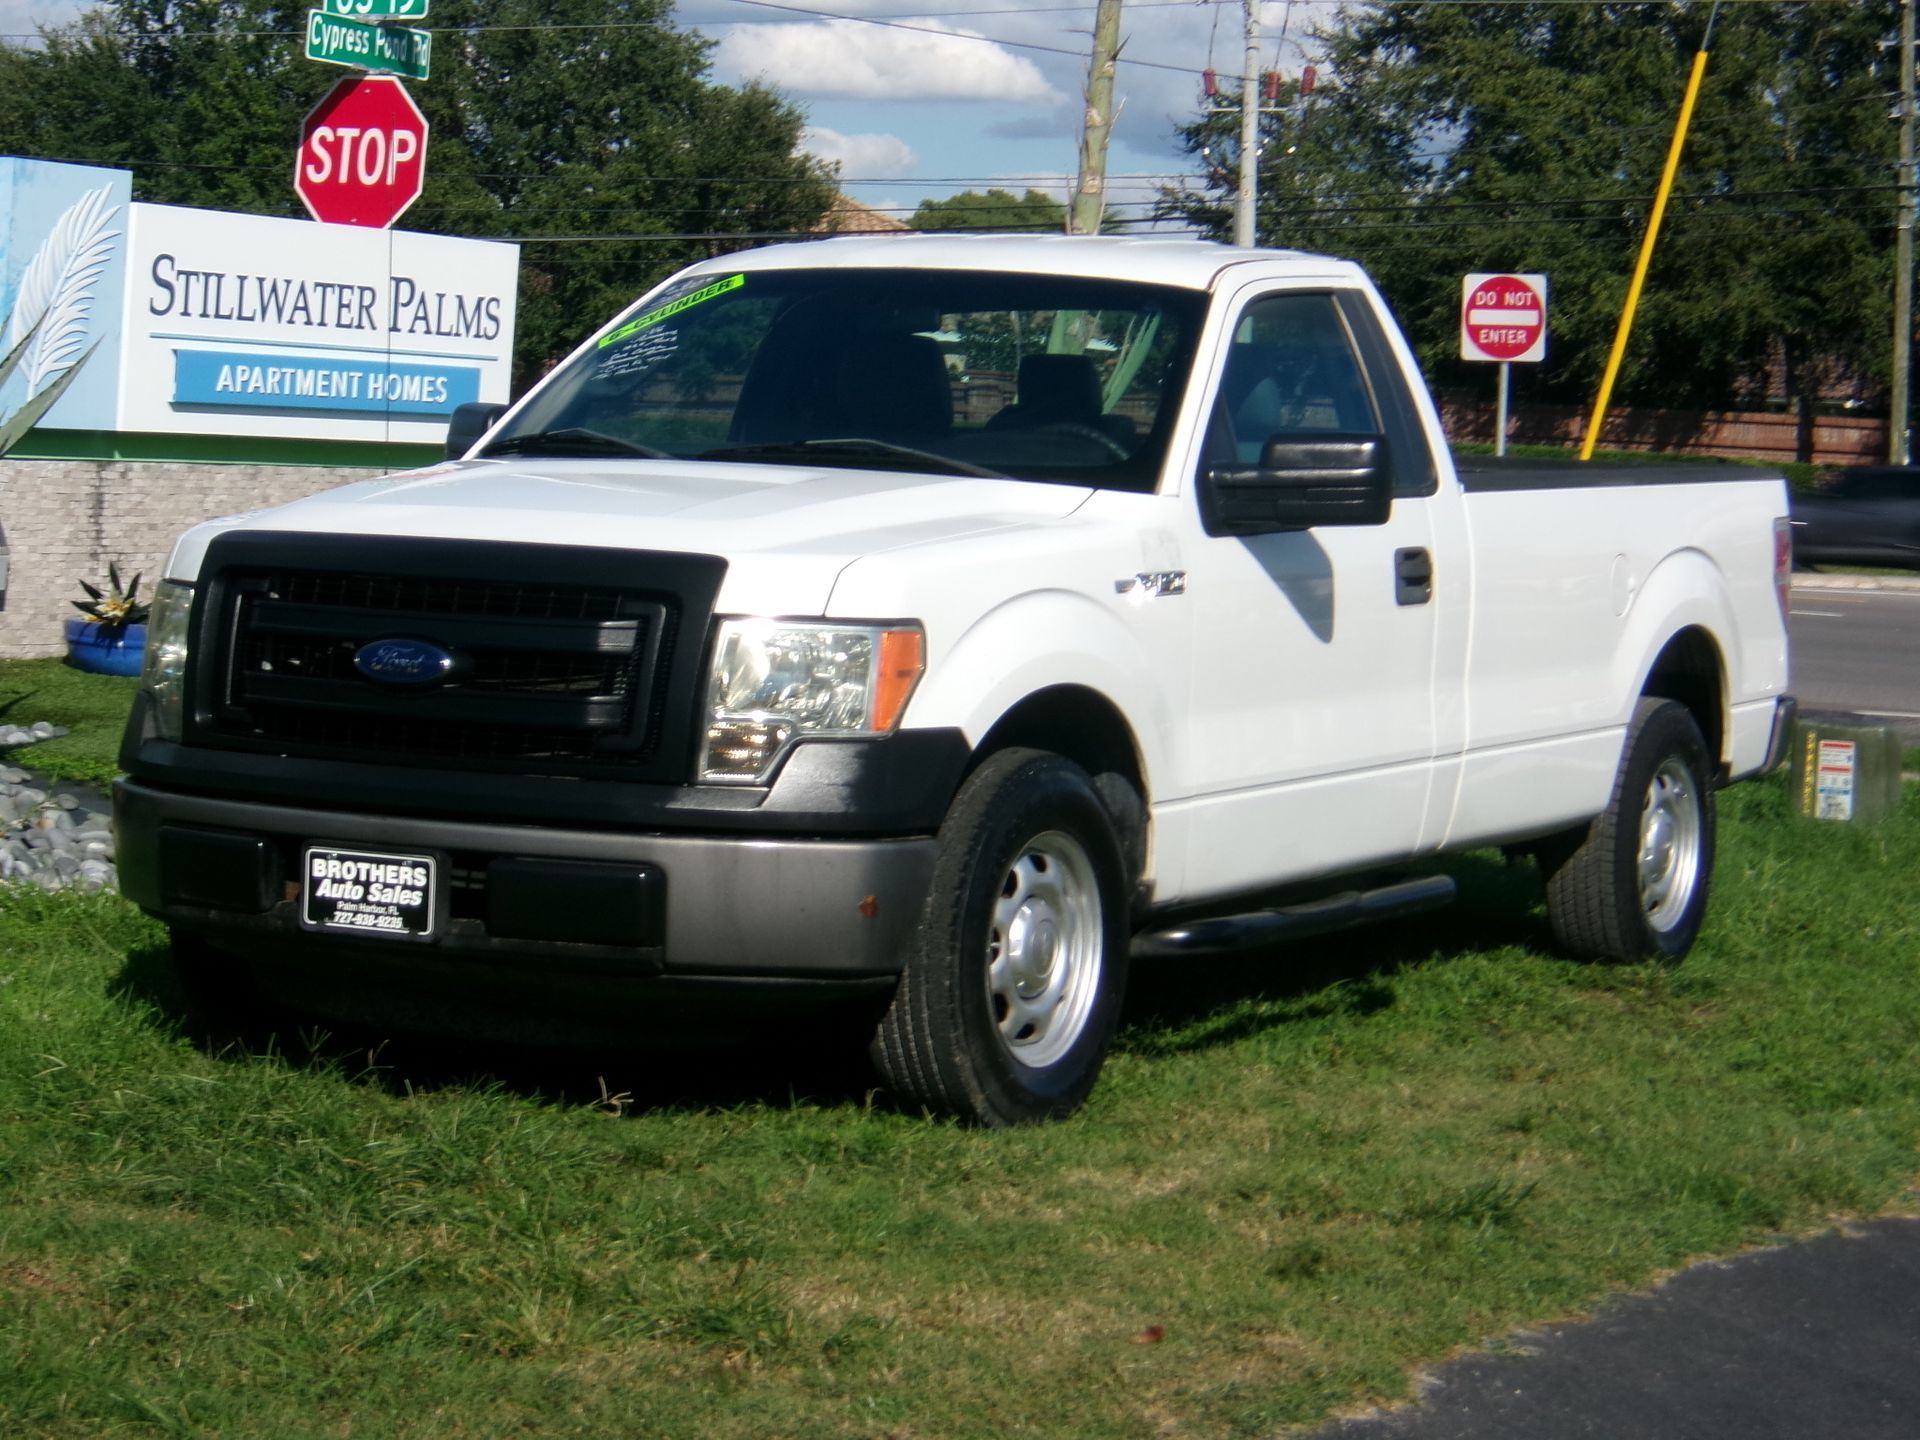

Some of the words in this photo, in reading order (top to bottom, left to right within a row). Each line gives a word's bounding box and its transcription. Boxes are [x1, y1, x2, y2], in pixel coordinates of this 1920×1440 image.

[311, 15, 369, 56] Cypress
[374, 27, 408, 61] Pond
[412, 34, 430, 66] Rd
[305, 125, 417, 186] STOP
[149, 252, 378, 332] STILLWATER
[389, 276, 501, 341] PALMS
[1475, 290, 1497, 306] DO
[1503, 290, 1535, 306] NOT
[1479, 328, 1527, 344] ENTER
[215, 363, 363, 400] APARTMENT
[367, 373, 449, 404] HOMES
[369, 645, 425, 673] Ford
[311, 857, 428, 887] BROTHERS
[315, 878, 365, 900] Auto
[366, 882, 423, 906] Sales
[336, 900, 358, 912] Palm
